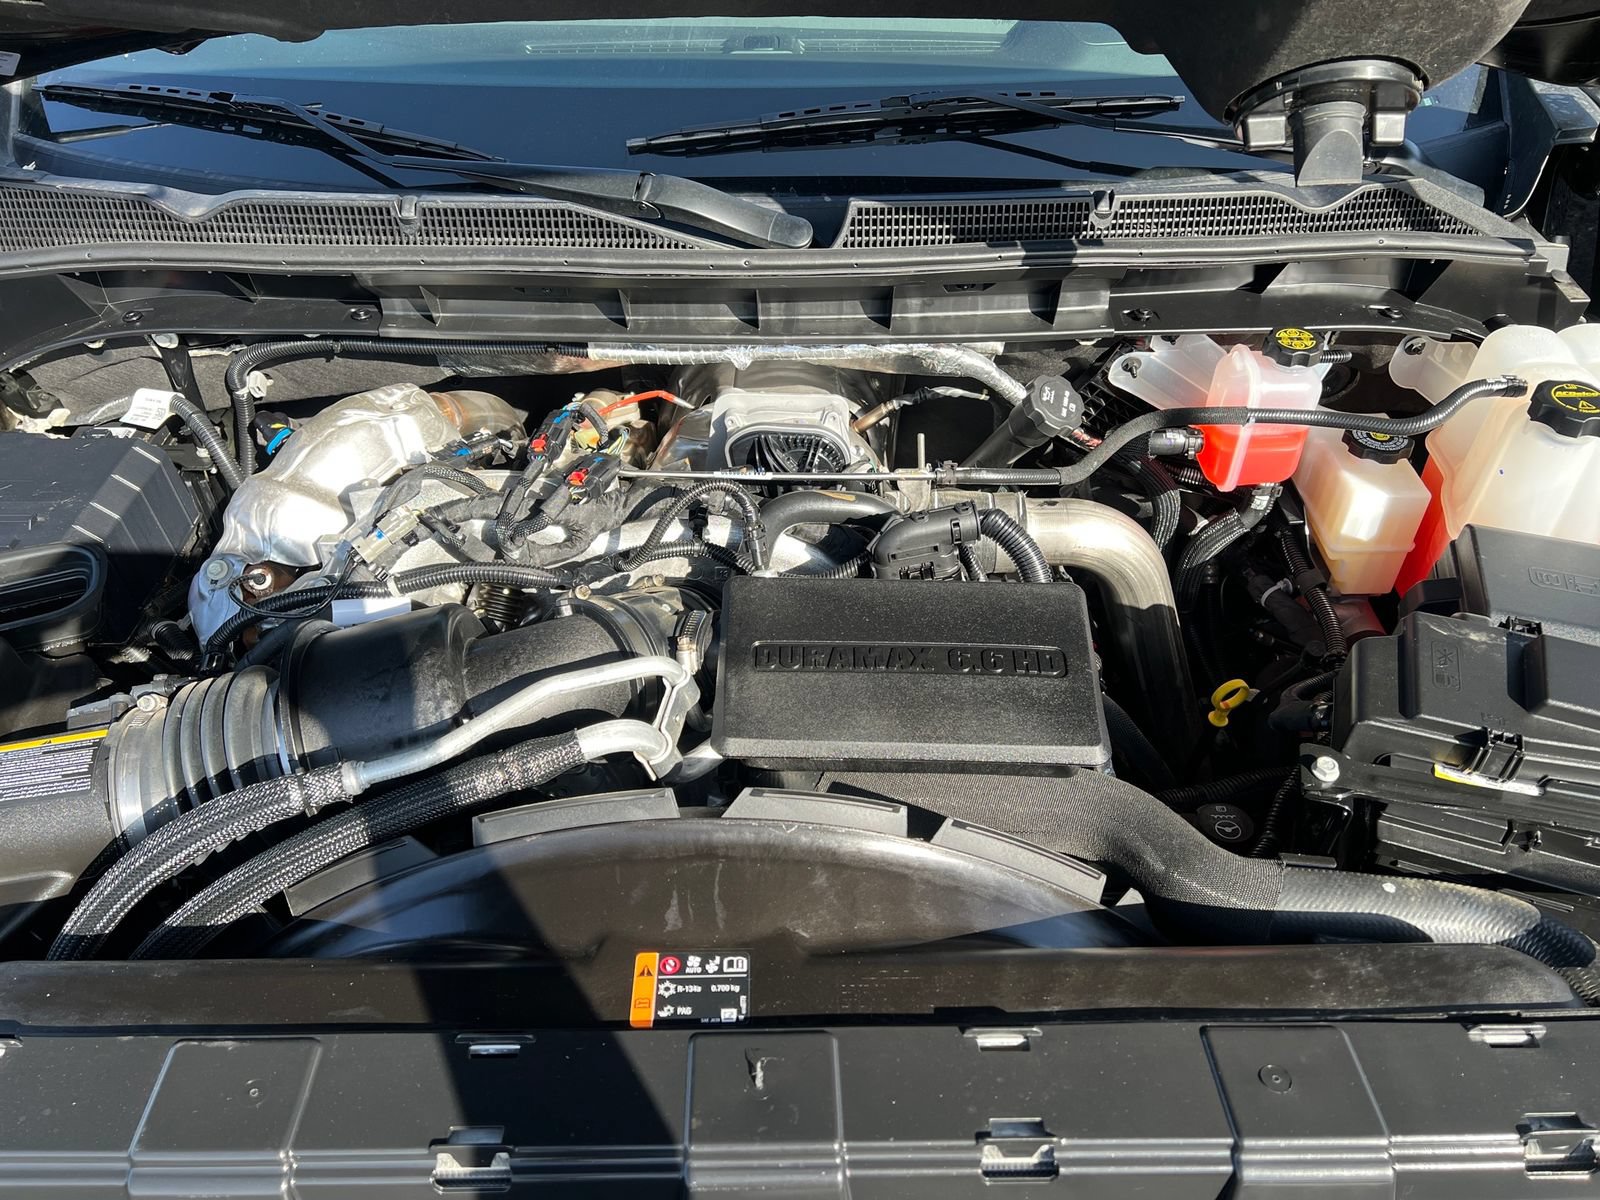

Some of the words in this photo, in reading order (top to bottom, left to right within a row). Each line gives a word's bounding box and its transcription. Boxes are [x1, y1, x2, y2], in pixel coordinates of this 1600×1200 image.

[755, 645, 935, 670] DURAMAX
[948, 648, 1004, 673] 6.6
[1014, 650, 1061, 675] HD
[677, 985, 702, 993] R-134a
[711, 984, 730, 993] 0.700
[731, 984, 740, 994] kg
[677, 1007, 693, 1015] PAG
